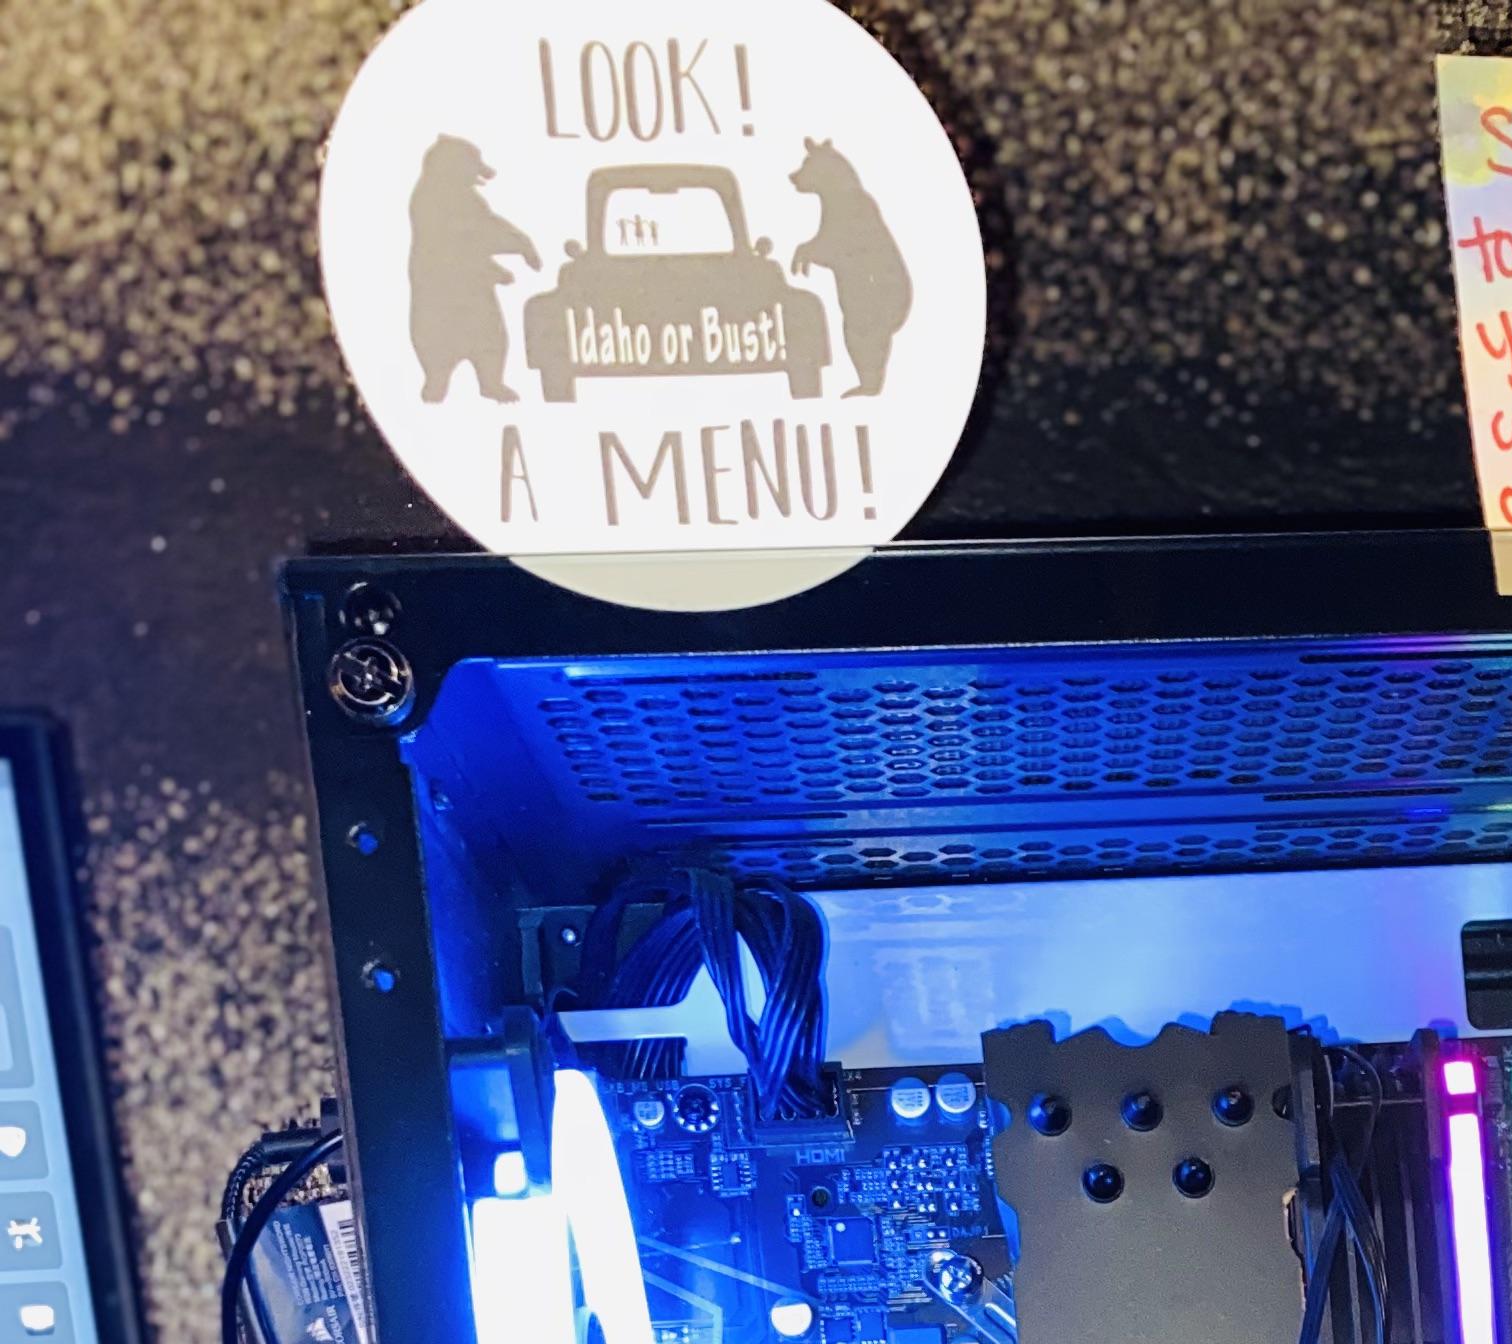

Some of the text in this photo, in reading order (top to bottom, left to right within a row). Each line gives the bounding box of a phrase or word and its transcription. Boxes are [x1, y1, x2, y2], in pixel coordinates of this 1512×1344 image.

[540, 38, 755, 141] LOOK!
[563, 302, 788, 366] Idaho or Bust!
[501, 418, 878, 527] A MENU!
[796, 1148, 846, 1166] HDMI
